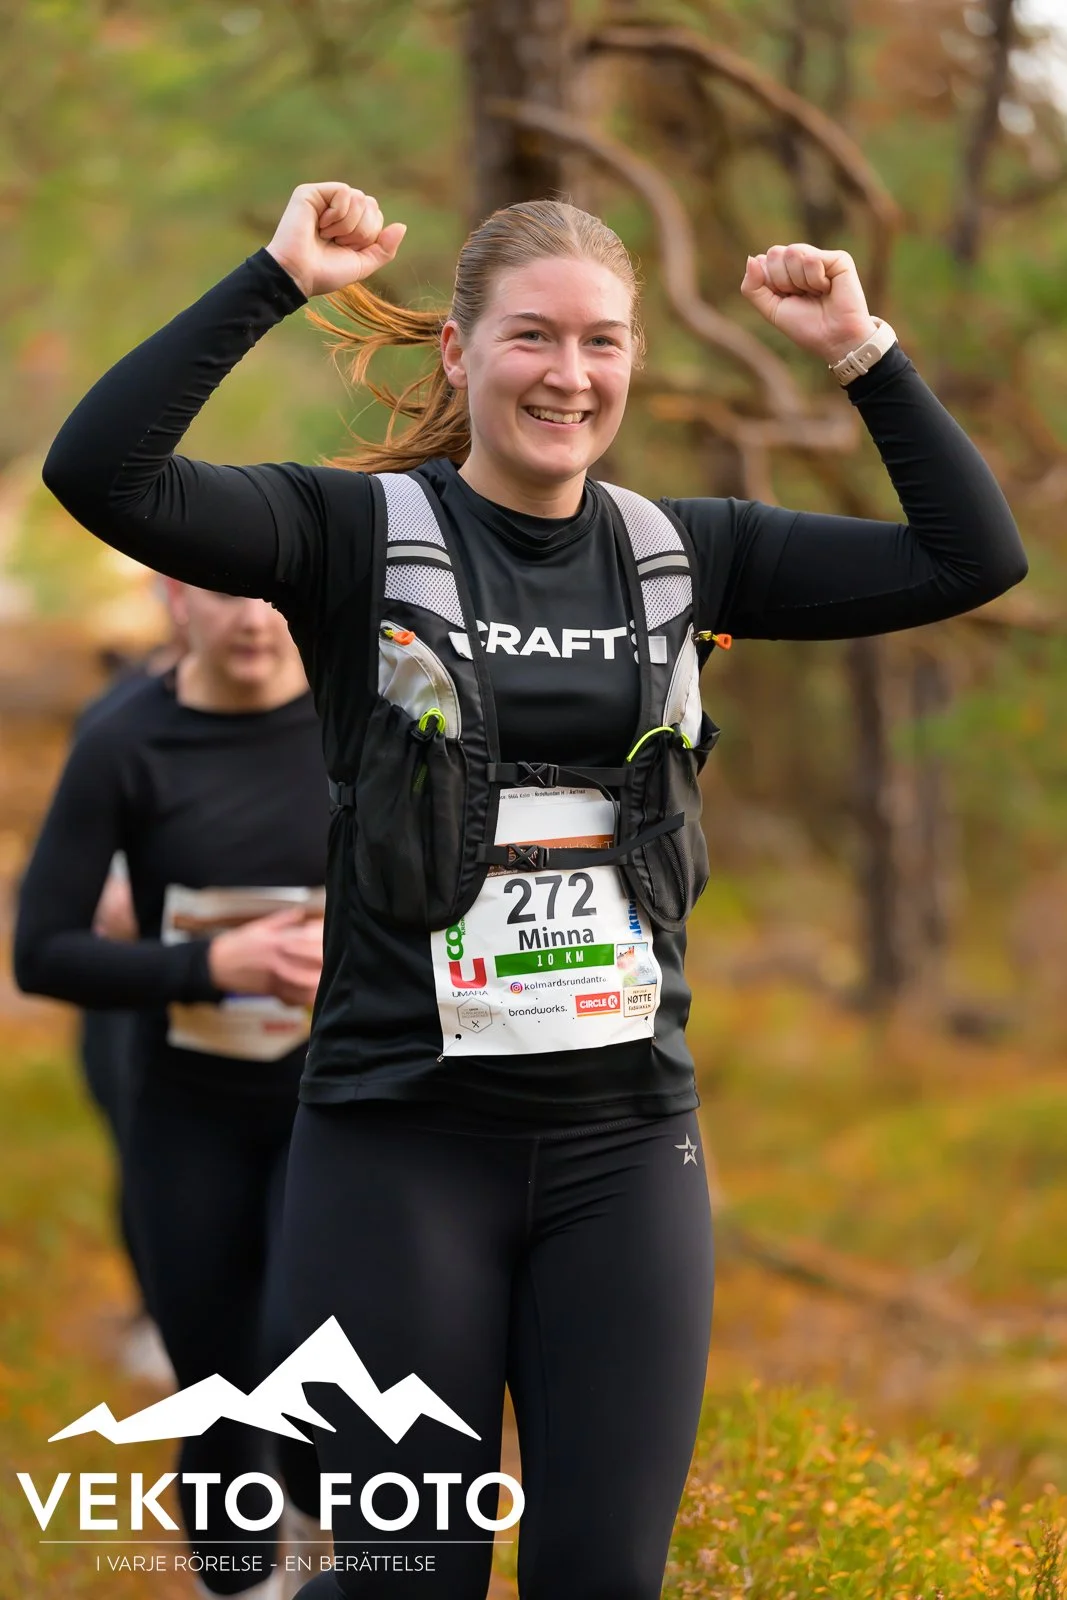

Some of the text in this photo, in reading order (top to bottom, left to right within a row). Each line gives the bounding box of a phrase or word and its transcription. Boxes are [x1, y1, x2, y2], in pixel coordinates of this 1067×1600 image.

[503, 872, 597, 925] 272
[518, 928, 595, 951] Minna
[537, 950, 584, 967] 10 KM
[579, 999, 607, 1009] CIRCLE
[627, 993, 652, 1005] NØTTE
[508, 1005, 567, 1017] brandworks.
